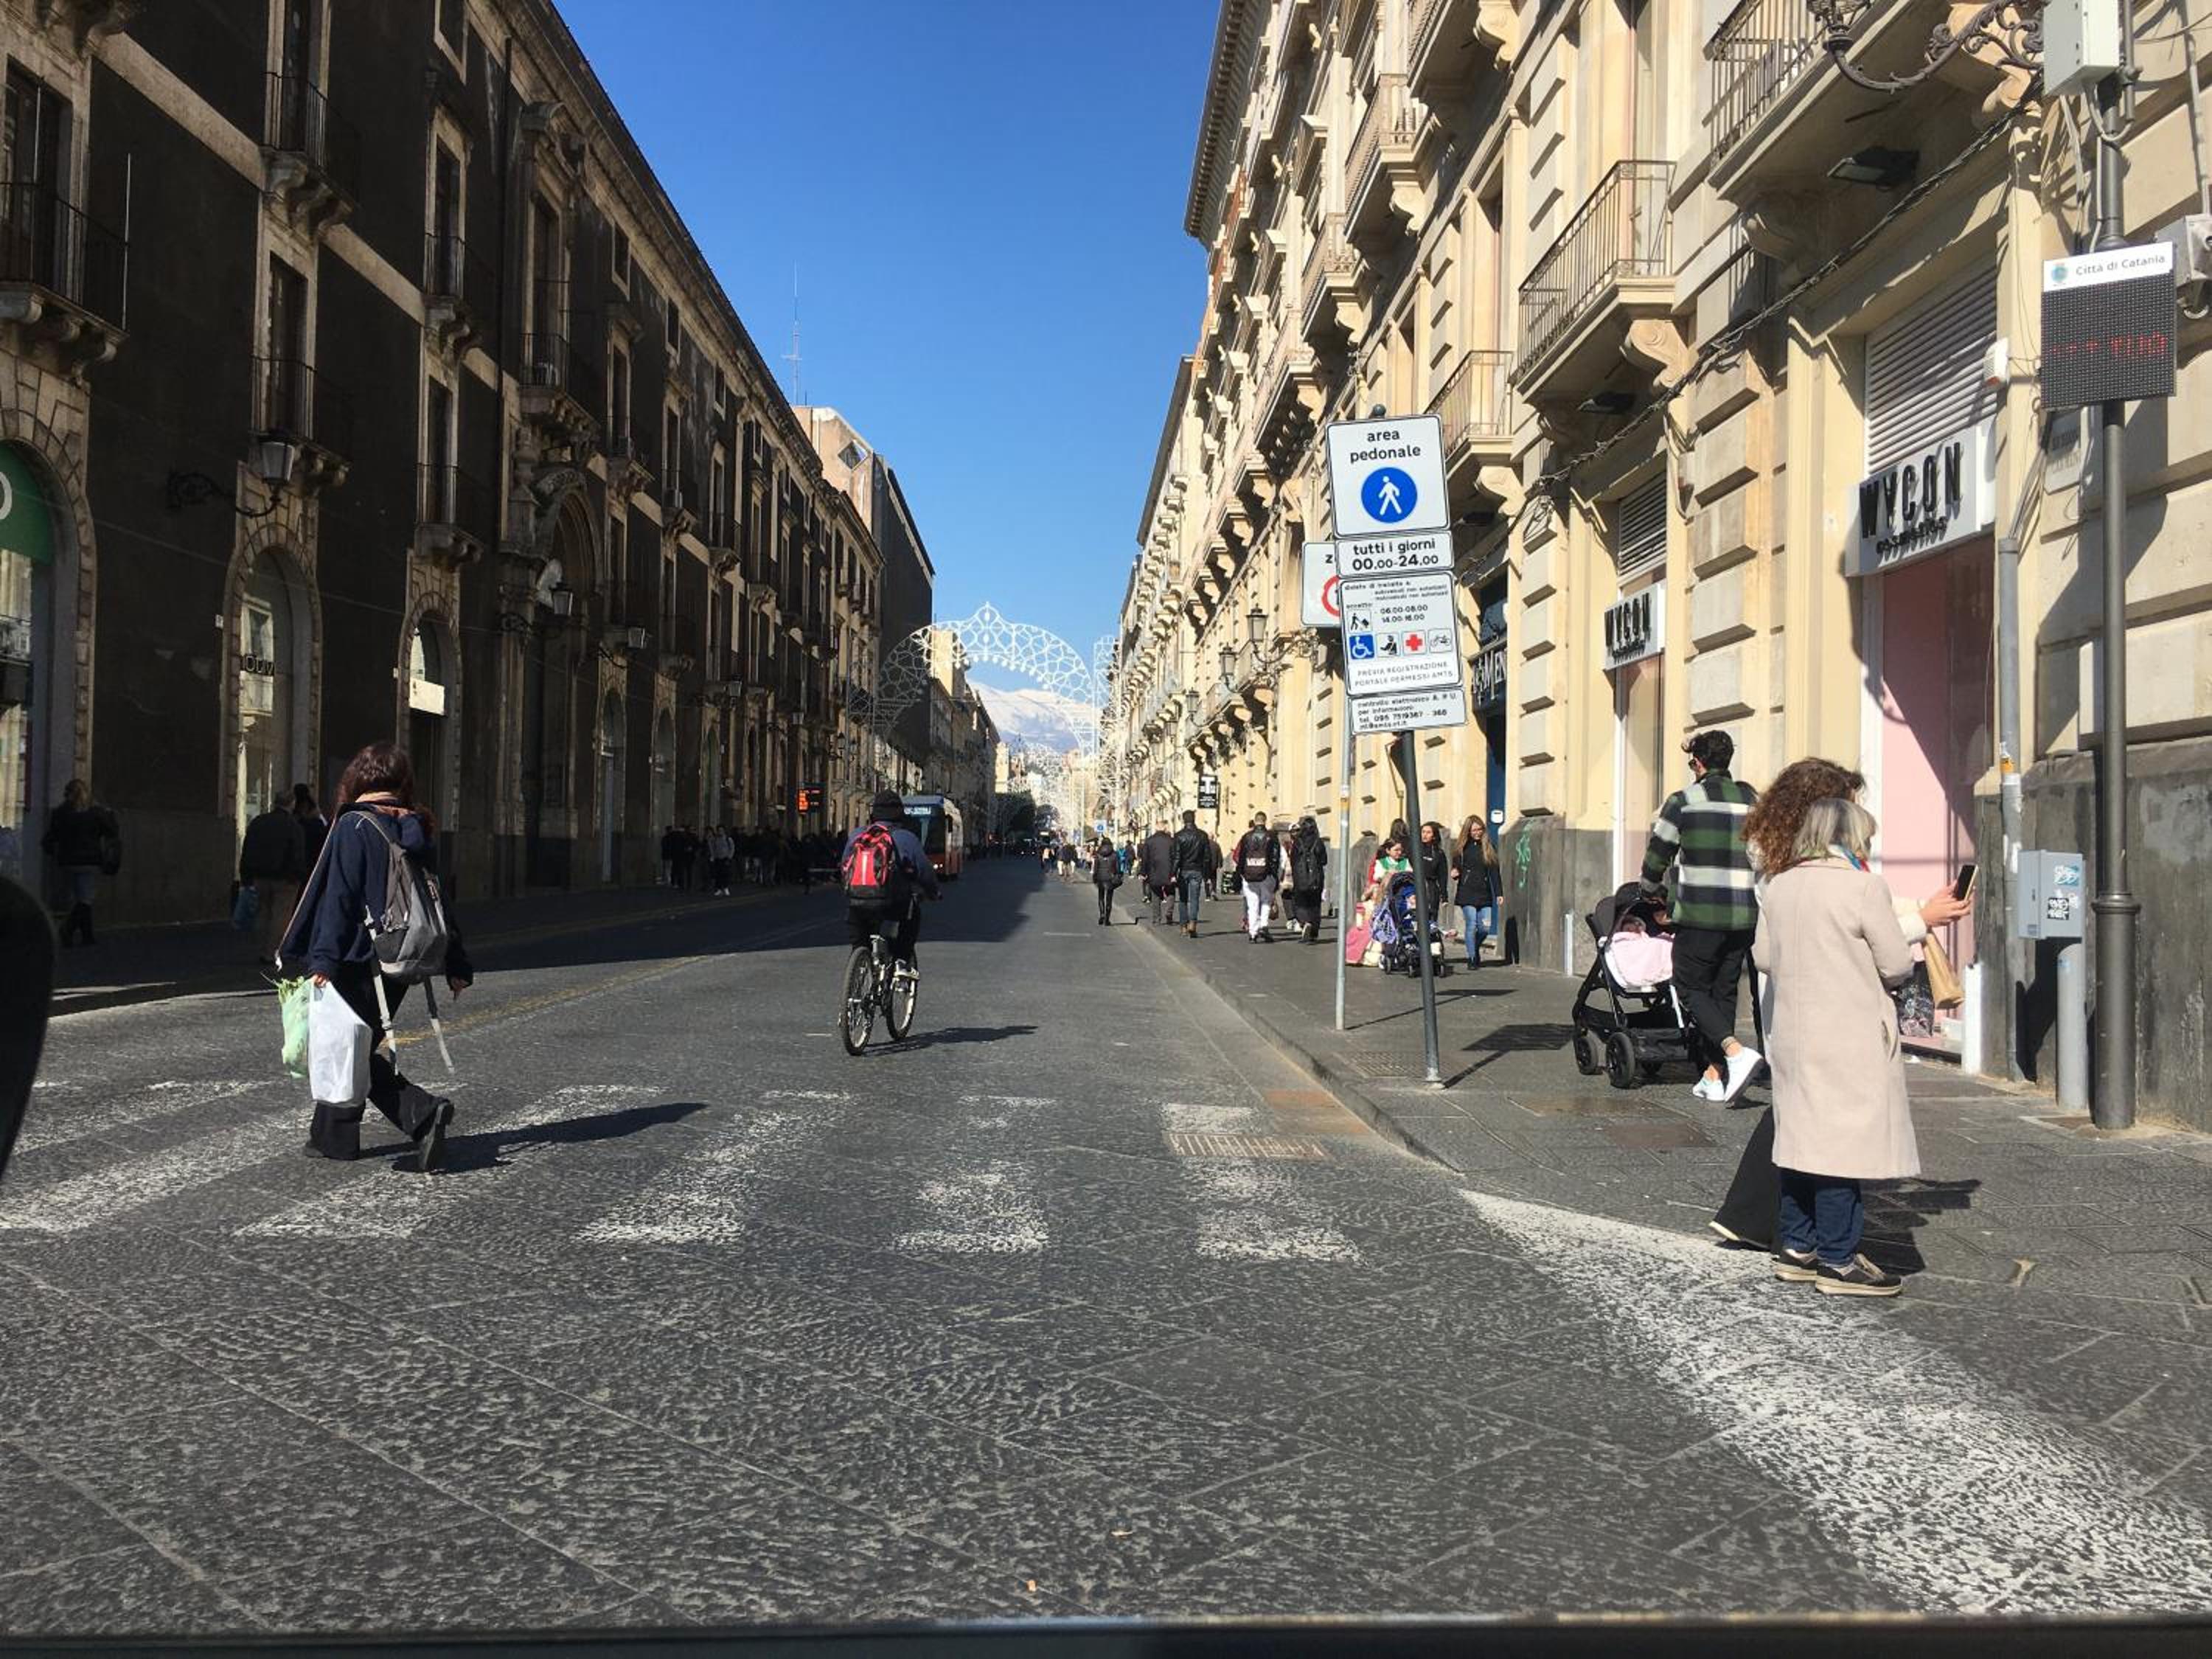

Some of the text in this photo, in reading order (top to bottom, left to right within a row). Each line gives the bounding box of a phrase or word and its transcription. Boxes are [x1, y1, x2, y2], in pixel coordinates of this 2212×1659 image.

[2076, 254, 2166, 276] Città di Catania
[1367, 430, 1400, 442] area
[1350, 445, 1421, 464] pedonale
[1860, 442, 1961, 538] WYCON
[1353, 538, 1436, 555] tutti i giorni
[1352, 554, 1439, 571] 00.00-24.00
